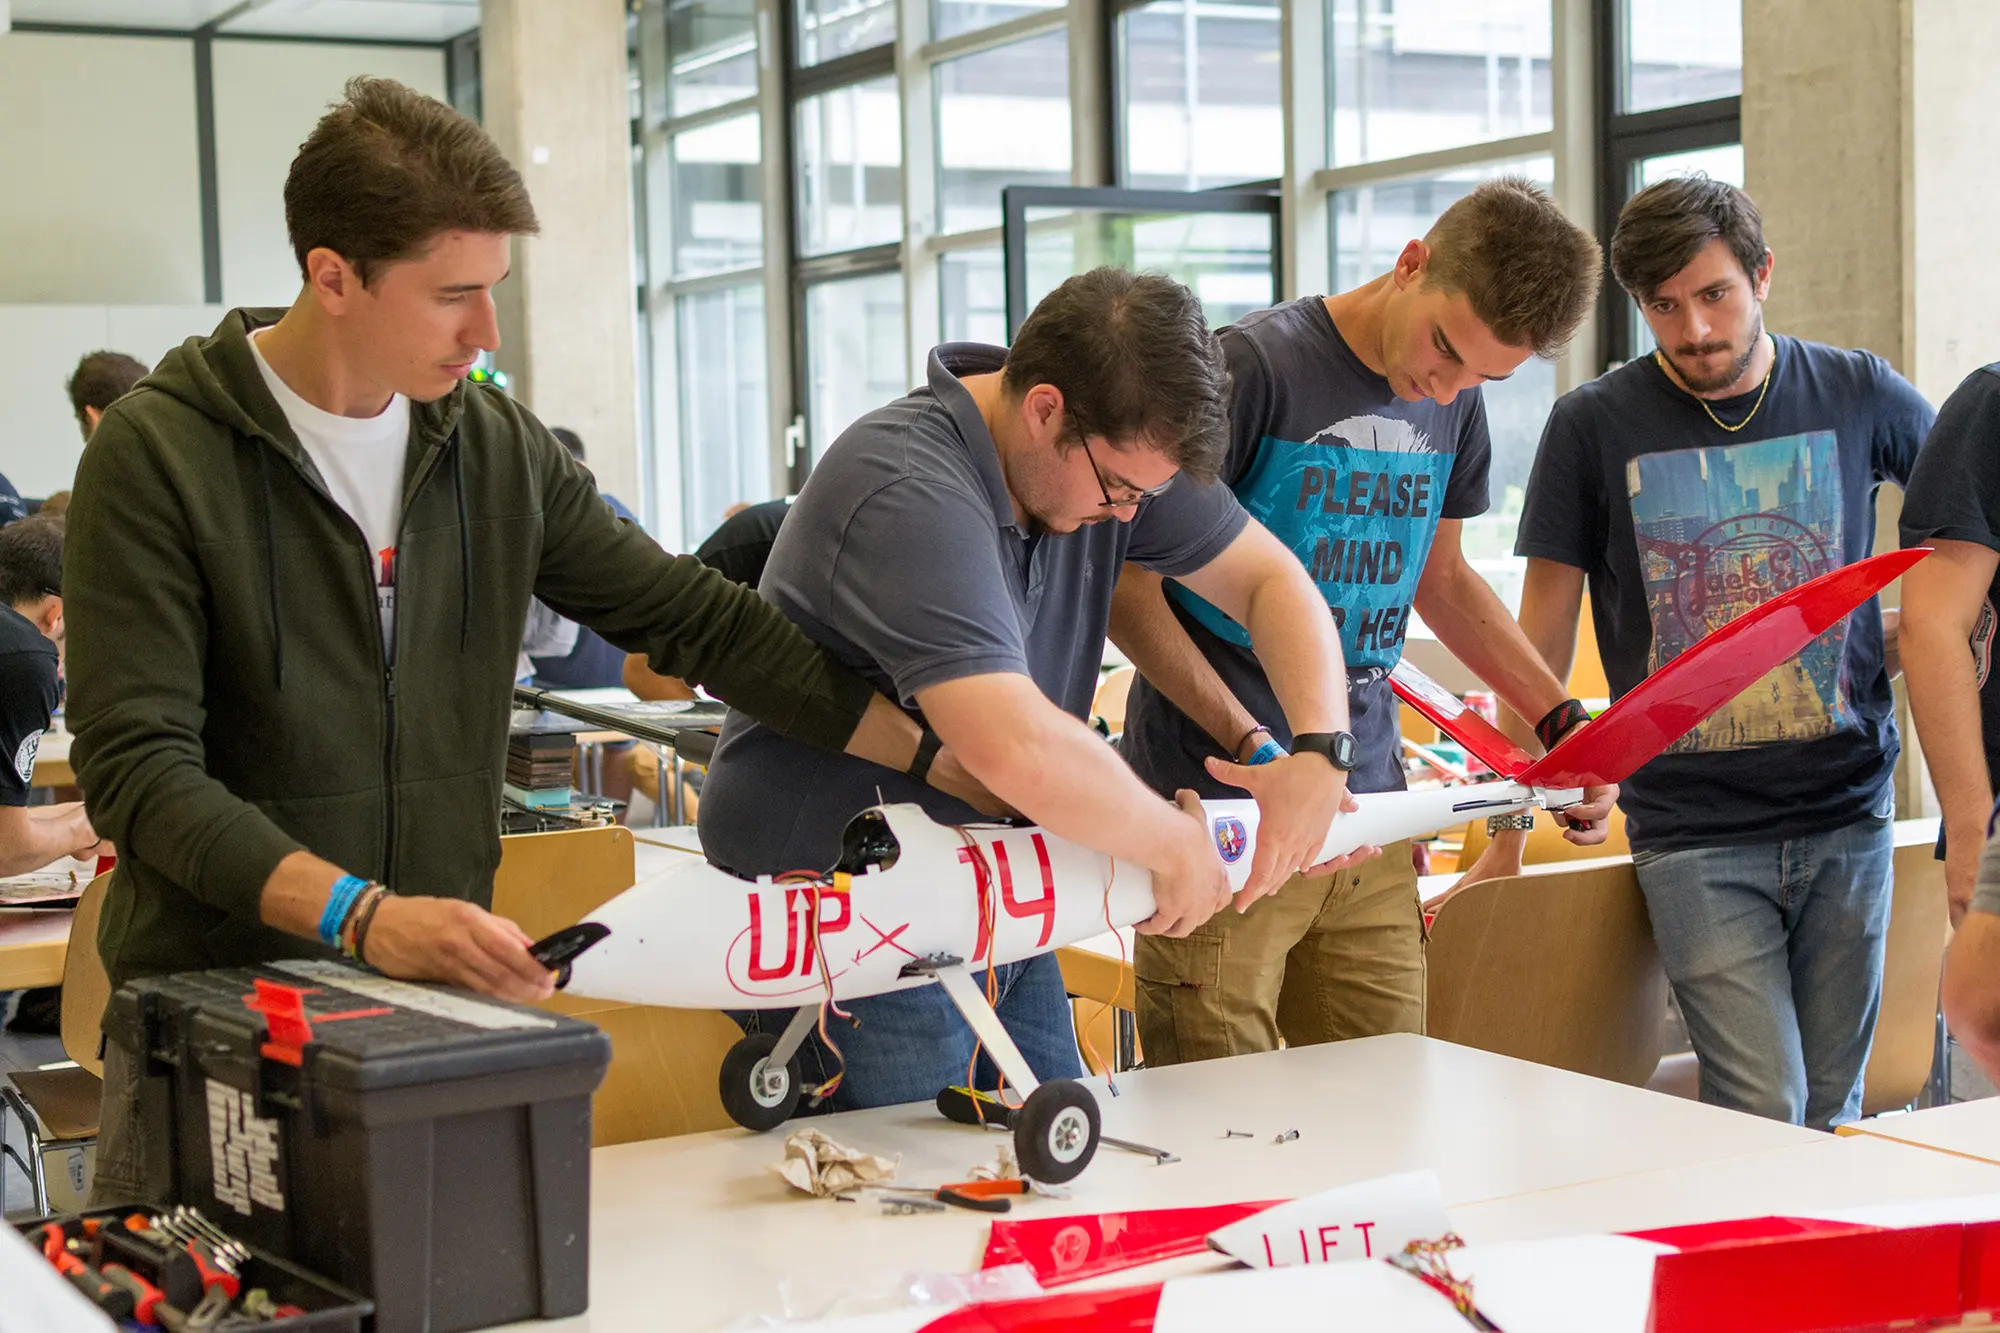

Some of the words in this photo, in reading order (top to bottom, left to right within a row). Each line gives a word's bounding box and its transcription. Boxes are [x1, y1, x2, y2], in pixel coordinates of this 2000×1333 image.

[1296, 466, 1431, 518] PLEASE
[1310, 537, 1404, 585] MIND
[748, 886, 850, 981] UP
[957, 833, 1056, 963] 14
[1262, 1222, 1375, 1268] LIFT
